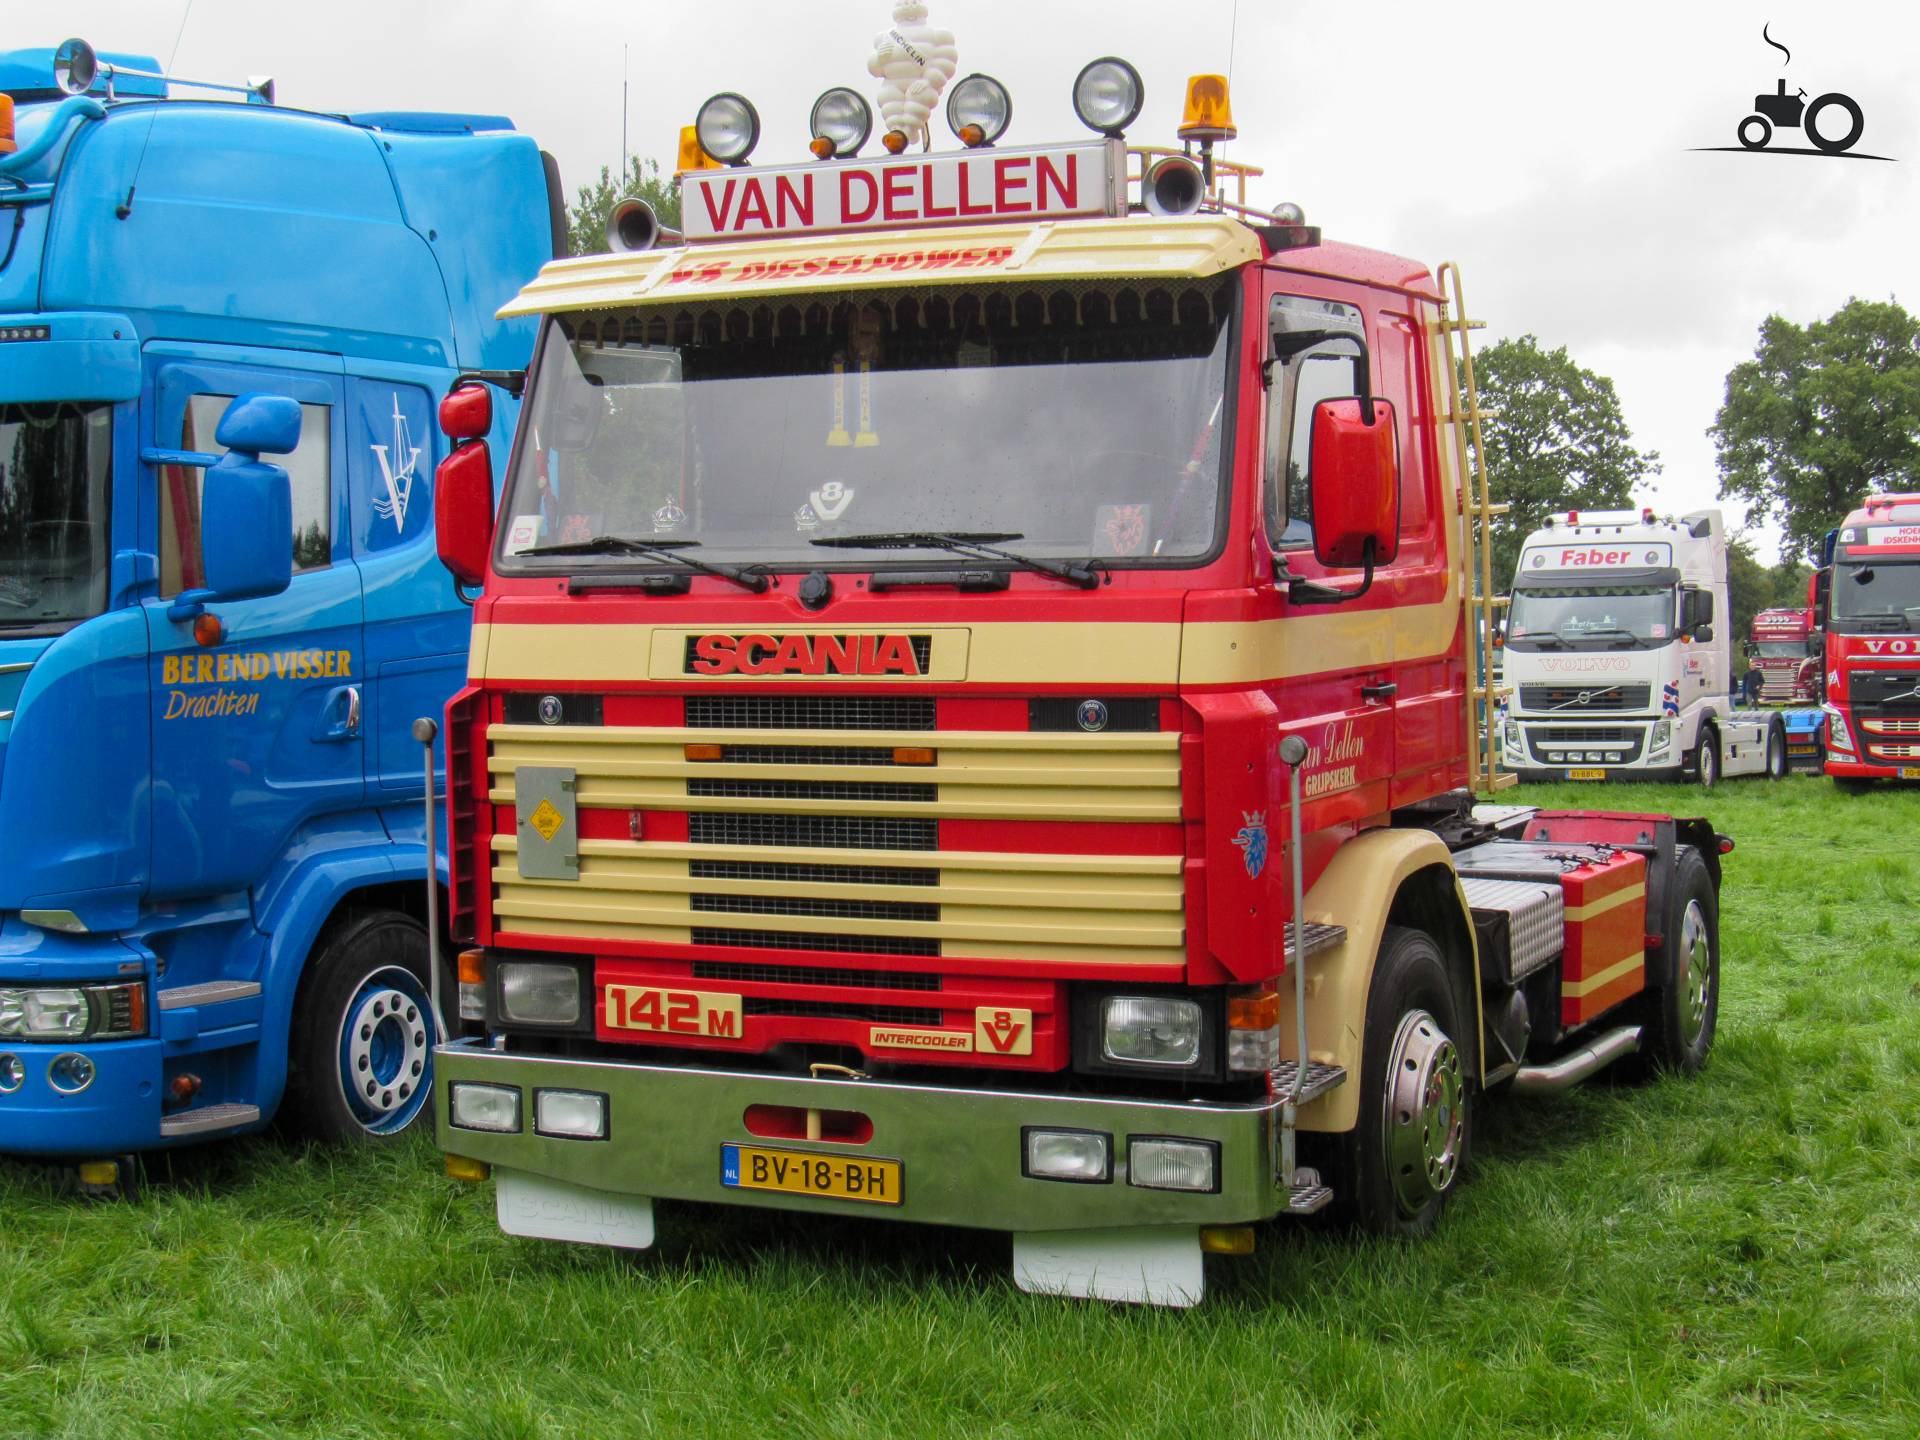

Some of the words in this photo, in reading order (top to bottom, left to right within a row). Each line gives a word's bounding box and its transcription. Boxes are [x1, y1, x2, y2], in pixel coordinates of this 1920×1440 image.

[889, 29, 926, 67] MICHELIN
[699, 173, 814, 232] VAN
[840, 153, 1078, 224] DELLEN
[730, 246, 1015, 282] DIESELPOWER
[1899, 527, 1920, 535] HOE
[1560, 549, 1631, 567] Faber
[163, 652, 270, 684] BEREND
[273, 650, 351, 680] VISSER
[692, 634, 920, 675] SCANIA
[1538, 656, 1632, 672] VOLVO
[163, 688, 260, 720] Drachten
[1324, 719, 1364, 764] Dellen
[1305, 765, 1356, 797] GRIJPSKERK
[874, 1033, 967, 1049] INTERCOOLER
[725, 1169, 738, 1180] NL
[752, 1154, 885, 1196] BV-18-BH
